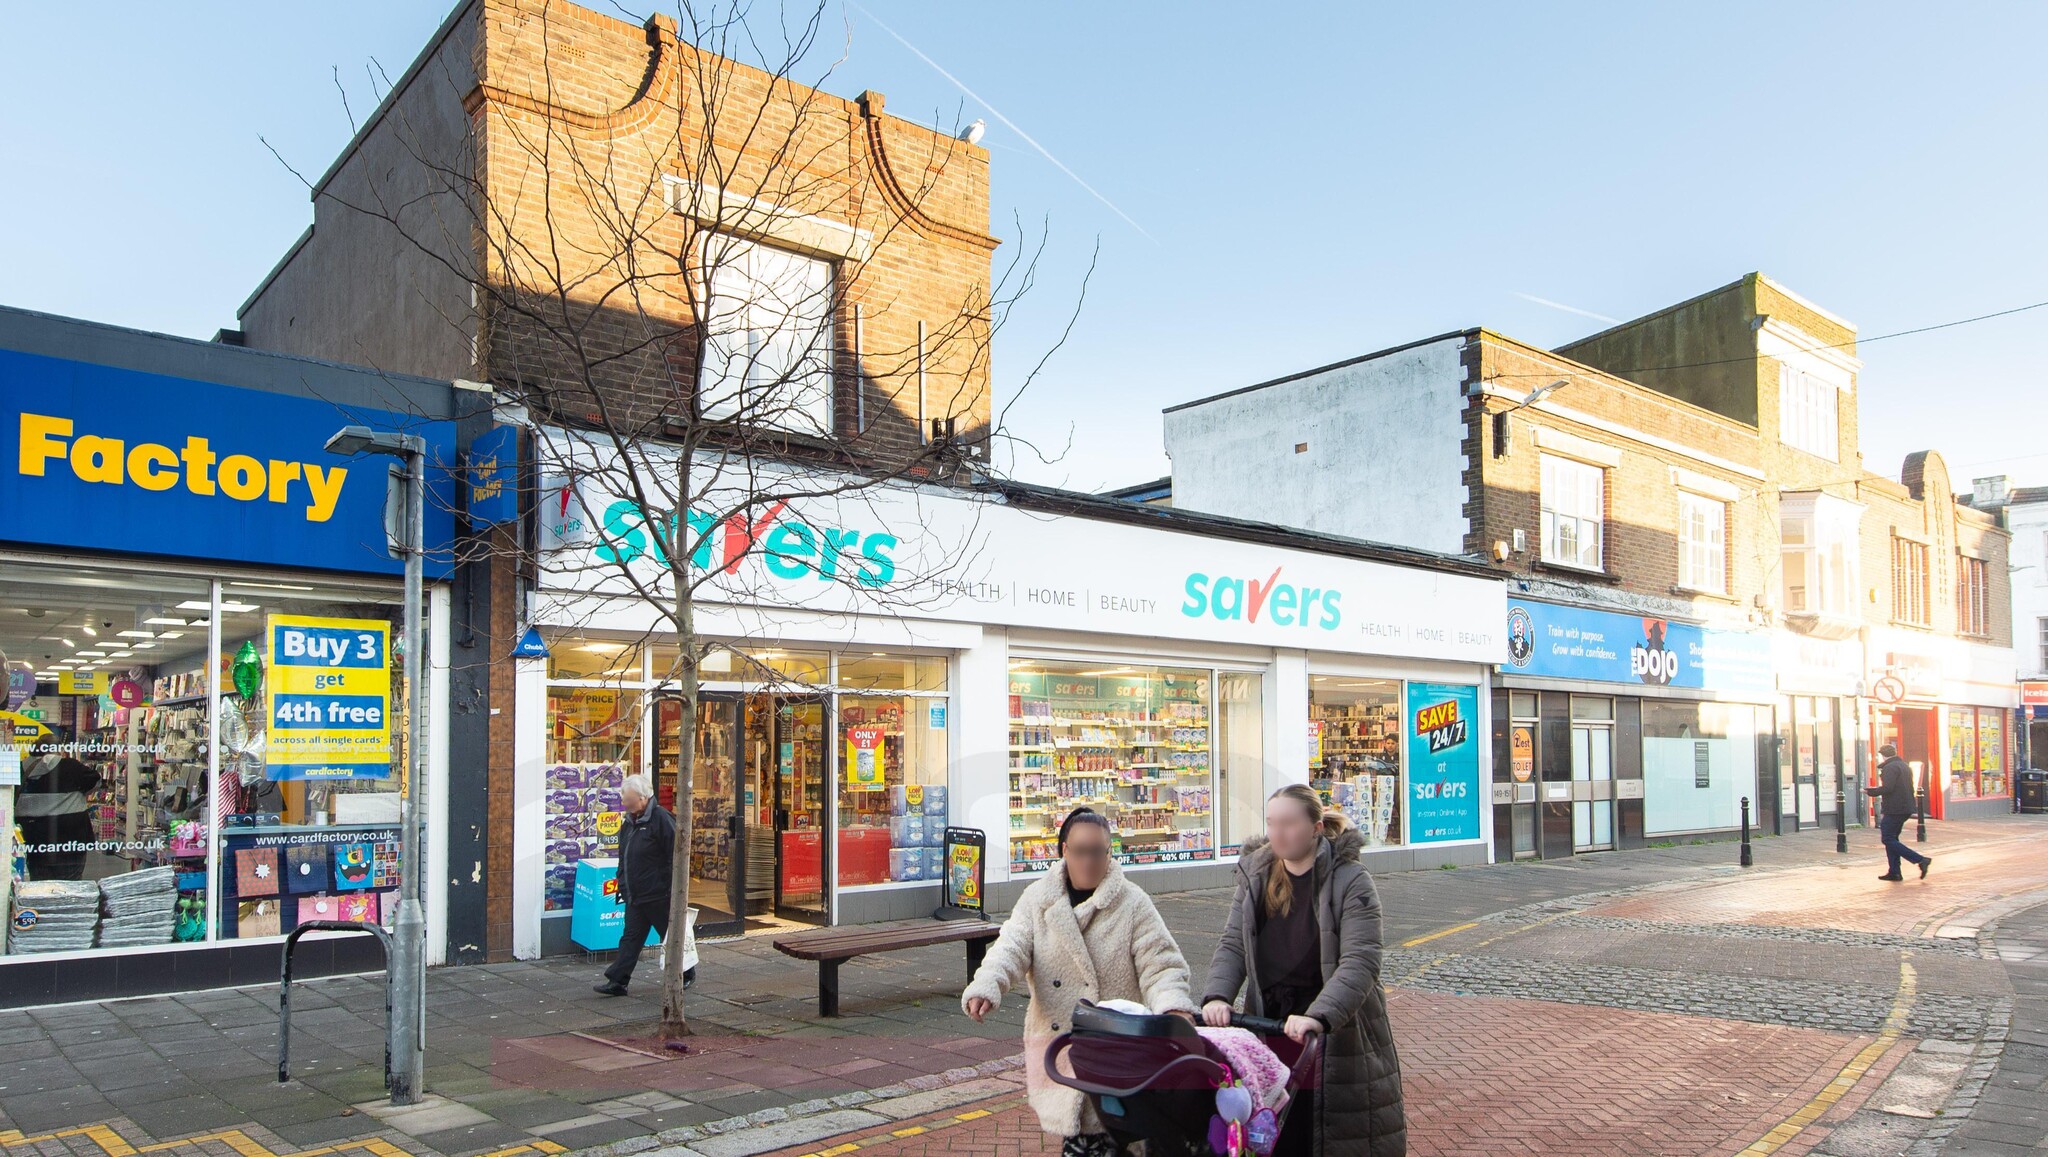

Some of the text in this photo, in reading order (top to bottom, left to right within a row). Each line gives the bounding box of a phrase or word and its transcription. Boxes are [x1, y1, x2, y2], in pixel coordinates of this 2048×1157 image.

[18, 412, 349, 522] Factory
[478, 455, 498, 480] Card
[473, 479, 503, 504] Factory
[554, 519, 581, 537] savers
[594, 497, 898, 588] savers
[932, 578, 1157, 614] HEALTH HOME BEAUTY
[1181, 566, 1342, 631] savers
[1361, 622, 1493, 646] HEALTH HOME BEAUTY
[1547, 624, 1605, 644] Train with purpose.
[284, 631, 376, 666] Buy 3
[524, 643, 543, 651] Chubb
[1552, 643, 1618, 660] Grow with confidence.
[1631, 647, 1639, 677] THE
[1638, 648, 1678, 683] DOJO
[314, 673, 345, 689] get
[1009, 681, 1032, 693] ers
[1055, 681, 1095, 696] savers
[1116, 684, 1154, 698] savers
[586, 695, 613, 704] PRICE
[276, 701, 381, 723] 4th free
[1419, 701, 1455, 731] SAVE
[15, 726, 37, 735] free
[855, 731, 877, 739] ONLY
[1432, 722, 1464, 750] 24/7
[273, 736, 306, 744] across
[309, 736, 320, 744] all
[323, 736, 353, 747] single
[861, 740, 871, 748] £1
[1514, 736, 1530, 748] Zest
[0, 742, 167, 755] www.cardfactory.co.uk
[305, 766, 353, 777] cardfactory
[1437, 761, 1447, 773] at
[1513, 762, 1532, 771] TO LET
[1416, 777, 1467, 799] savers
[1494, 789, 1512, 798] 149-151
[601, 813, 620, 821] LOW
[1440, 807, 1455, 817] Online
[1458, 807, 1468, 817] App
[797, 815, 809, 825] DAZ
[256, 830, 394, 846] www.cardfactory.co.uk
[12, 839, 165, 854] ww.cardfactory.co.uk
[957, 848, 972, 856] LOW
[955, 855, 972, 863] PRICE
[1162, 853, 1177, 861] 60%
[1032, 861, 1049, 870] 60%
[966, 884, 974, 893] £1
[600, 910, 625, 920] saver
